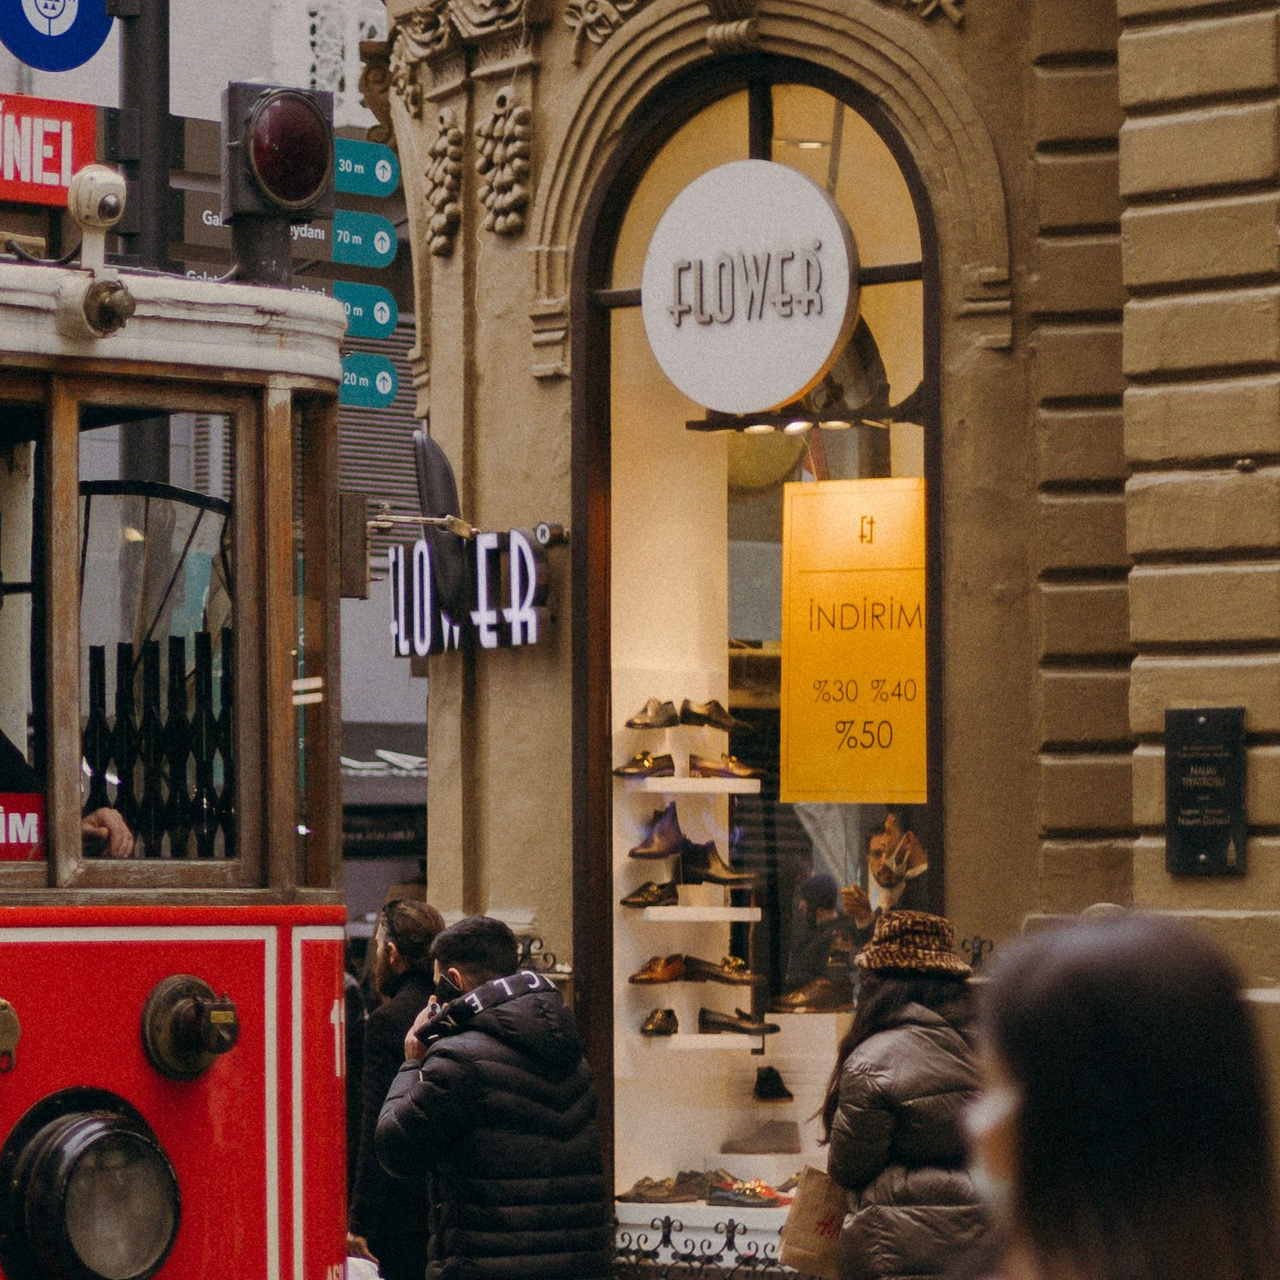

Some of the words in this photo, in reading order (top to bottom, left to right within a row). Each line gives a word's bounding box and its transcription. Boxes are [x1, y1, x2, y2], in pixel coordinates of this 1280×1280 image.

[339, 159, 352, 172] 30
[354, 164, 364, 174] m
[337, 230, 350, 243] 70
[352, 235, 362, 244] m
[669, 251, 824, 328] FLOWER
[353, 306, 363, 316] m
[359, 376, 369, 387] m
[388, 528, 538, 657] FLOER
[808, 598, 923, 632] İNDİRİM
[812, 679, 859, 704] %30
[870, 679, 918, 703] %40
[835, 720, 894, 750] %50
